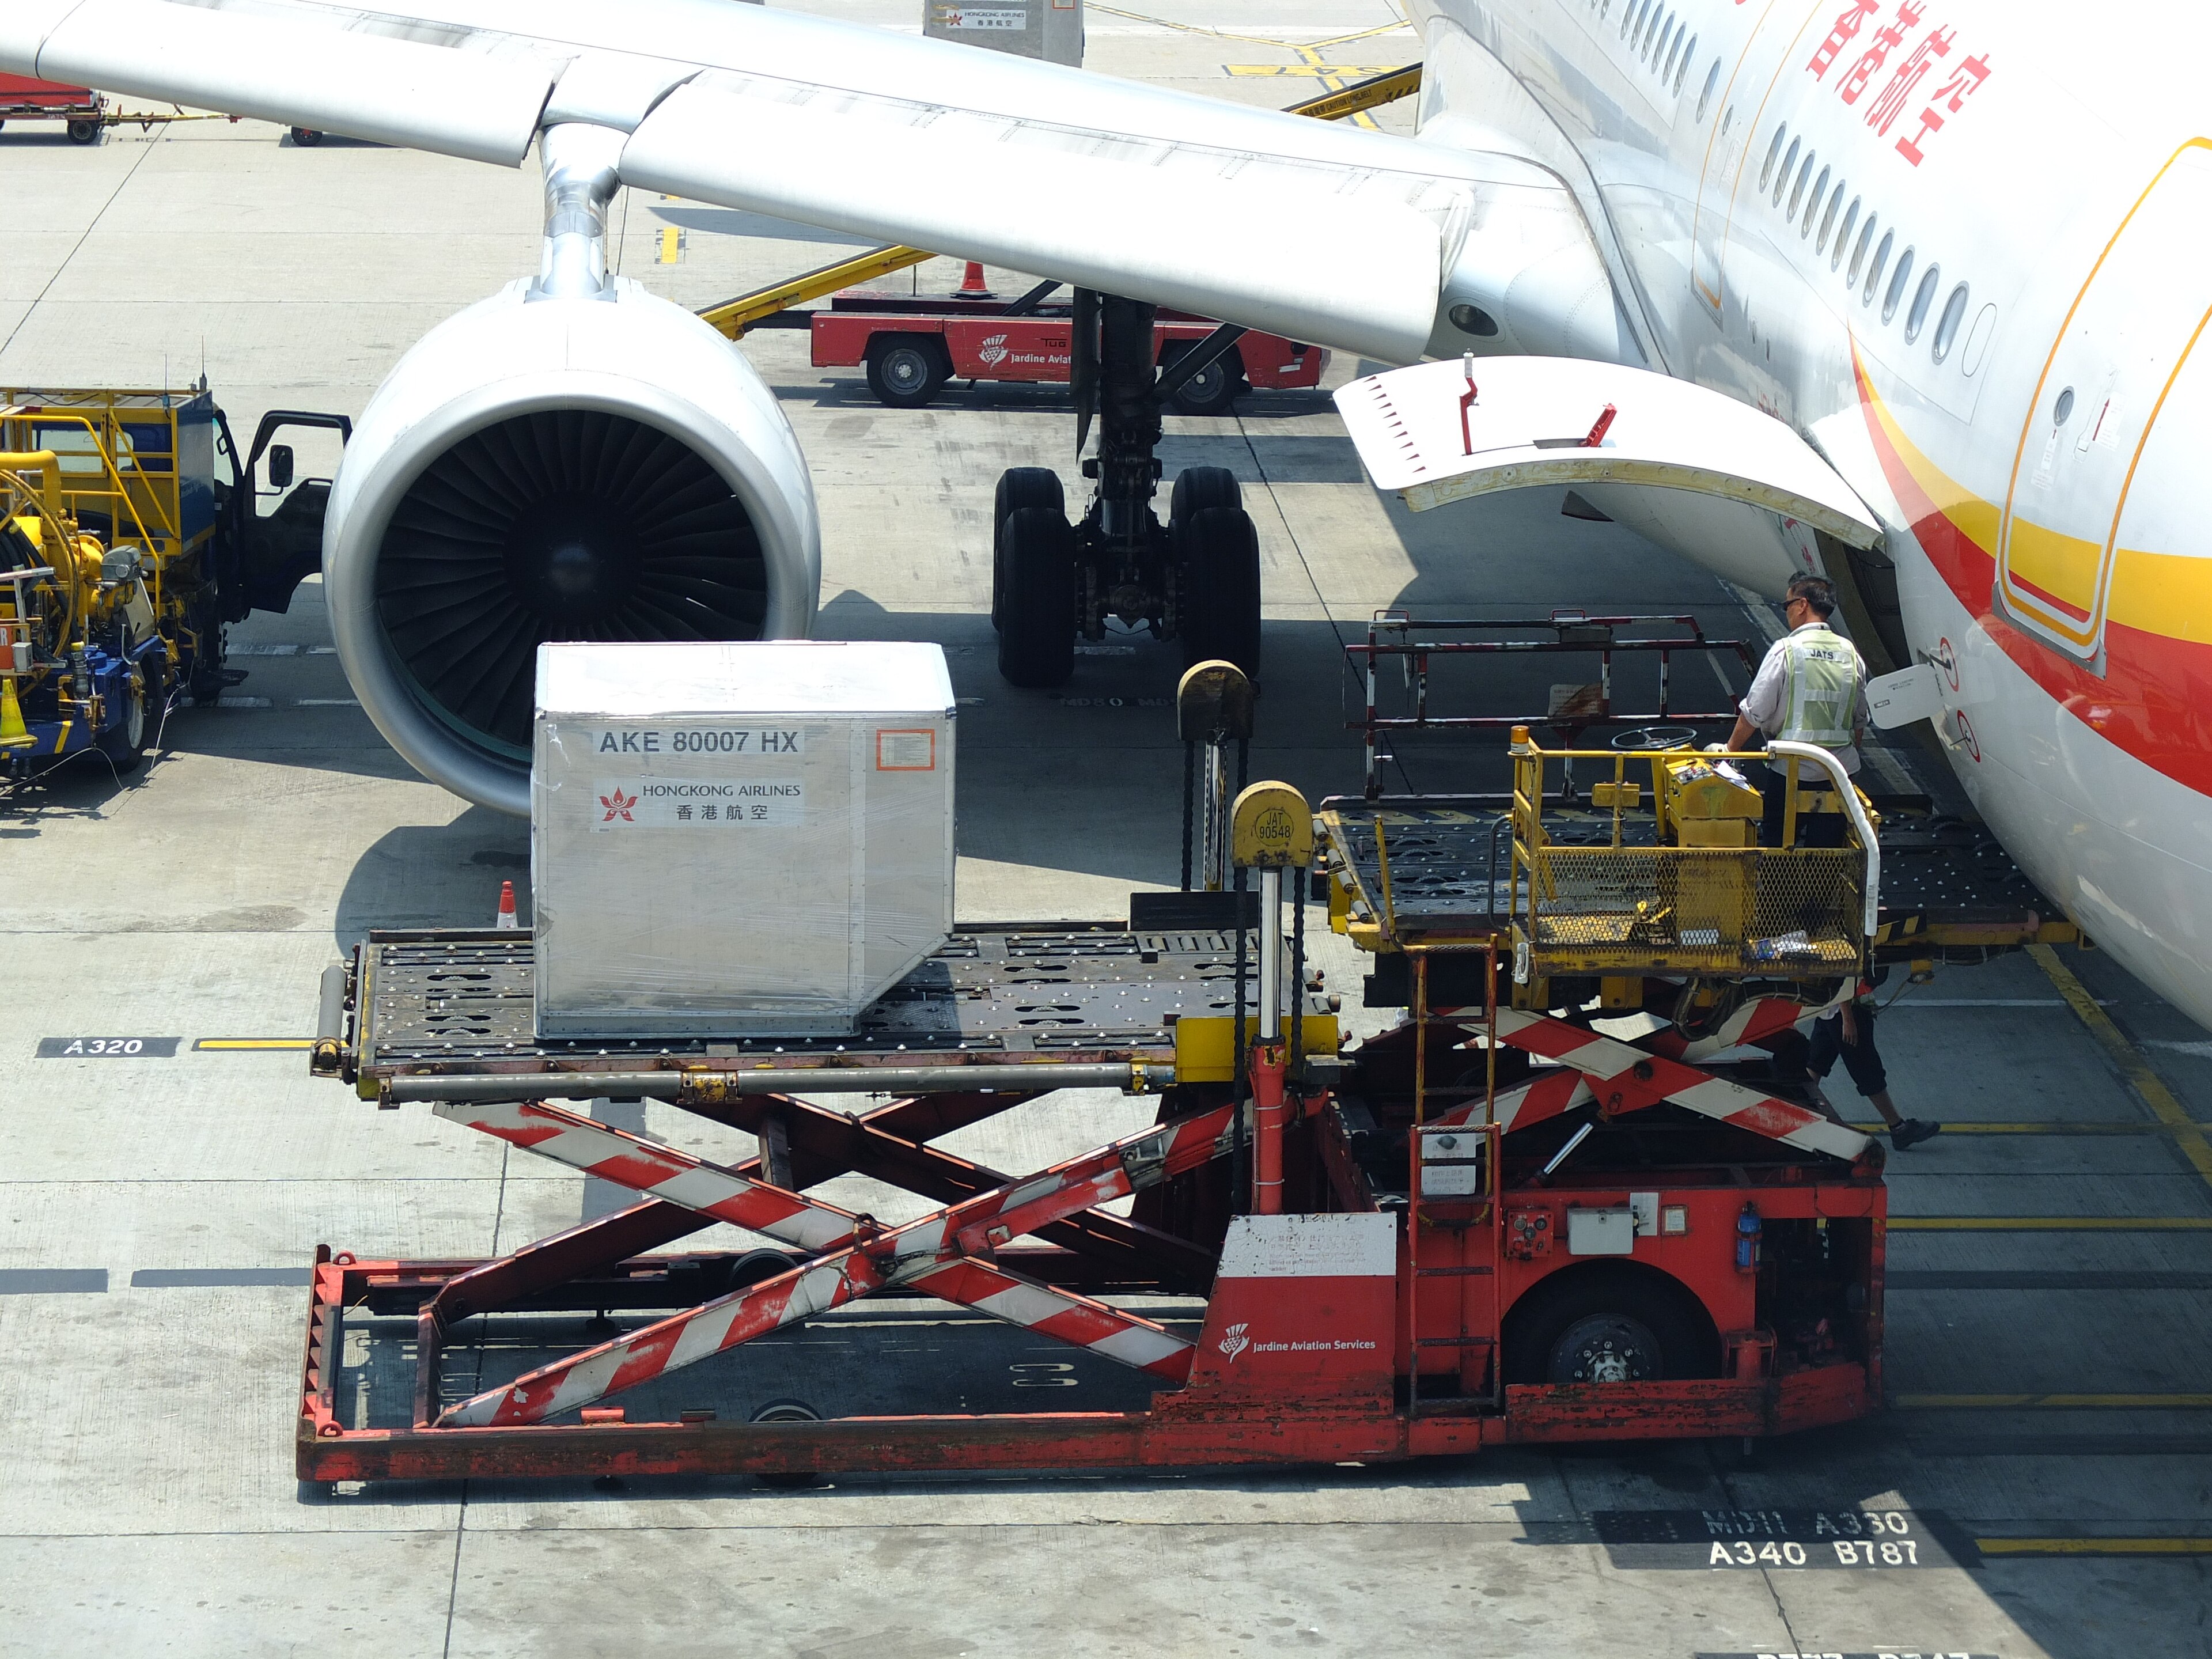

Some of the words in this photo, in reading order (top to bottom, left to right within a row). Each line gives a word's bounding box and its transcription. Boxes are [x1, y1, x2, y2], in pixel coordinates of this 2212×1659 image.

[1041, 339, 1067, 347] TUG
[1011, 354, 1045, 363] Jardine
[1810, 649, 1834, 660] JATS
[599, 731, 660, 752] AKE
[672, 730, 749, 752] 80007
[760, 730, 798, 752] HX
[642, 784, 733, 797] HONGKONG
[738, 783, 801, 797] AIRLINES
[676, 804, 768, 821] 香港航空
[1267, 812, 1284, 826] JAT
[1259, 825, 1291, 839] 90548
[63, 1039, 143, 1054] A320
[1253, 1341, 1288, 1353] Jardine
[1290, 1340, 1331, 1351] Aviation
[1334, 1339, 1376, 1350] Services
[1815, 1510, 1910, 1536] A330
[1709, 1540, 1807, 1566] A340
[1832, 1539, 1918, 1566] B787
